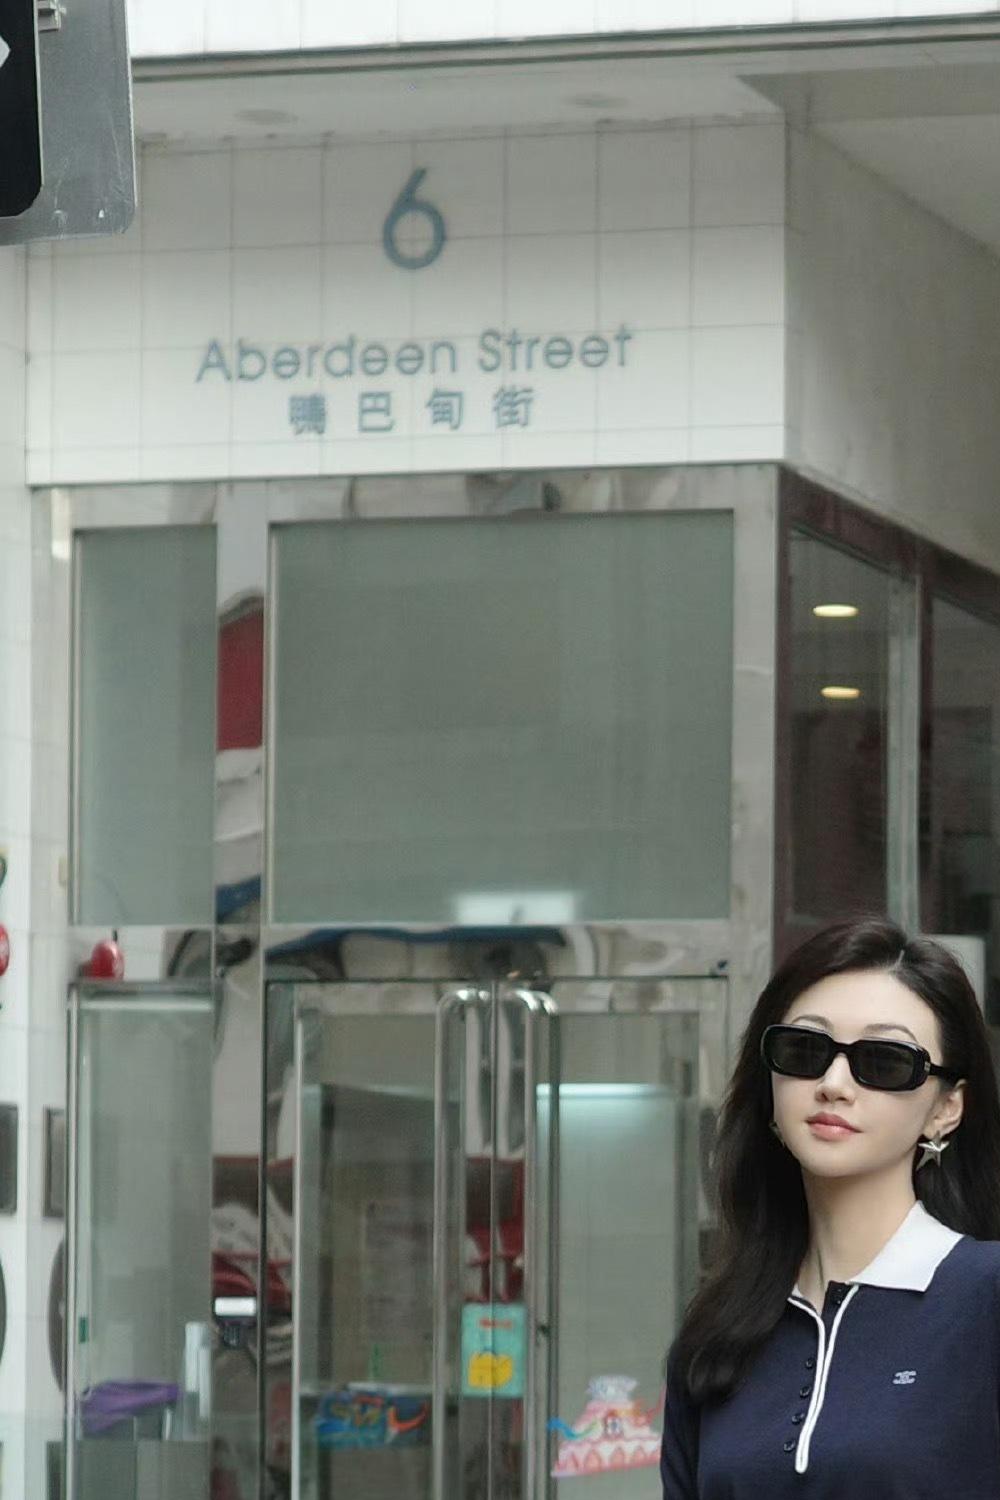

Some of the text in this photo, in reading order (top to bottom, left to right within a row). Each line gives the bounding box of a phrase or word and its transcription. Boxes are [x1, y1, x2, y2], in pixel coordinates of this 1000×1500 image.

[382, 167, 446, 269] 6
[195, 324, 633, 383] Aberdeen Street
